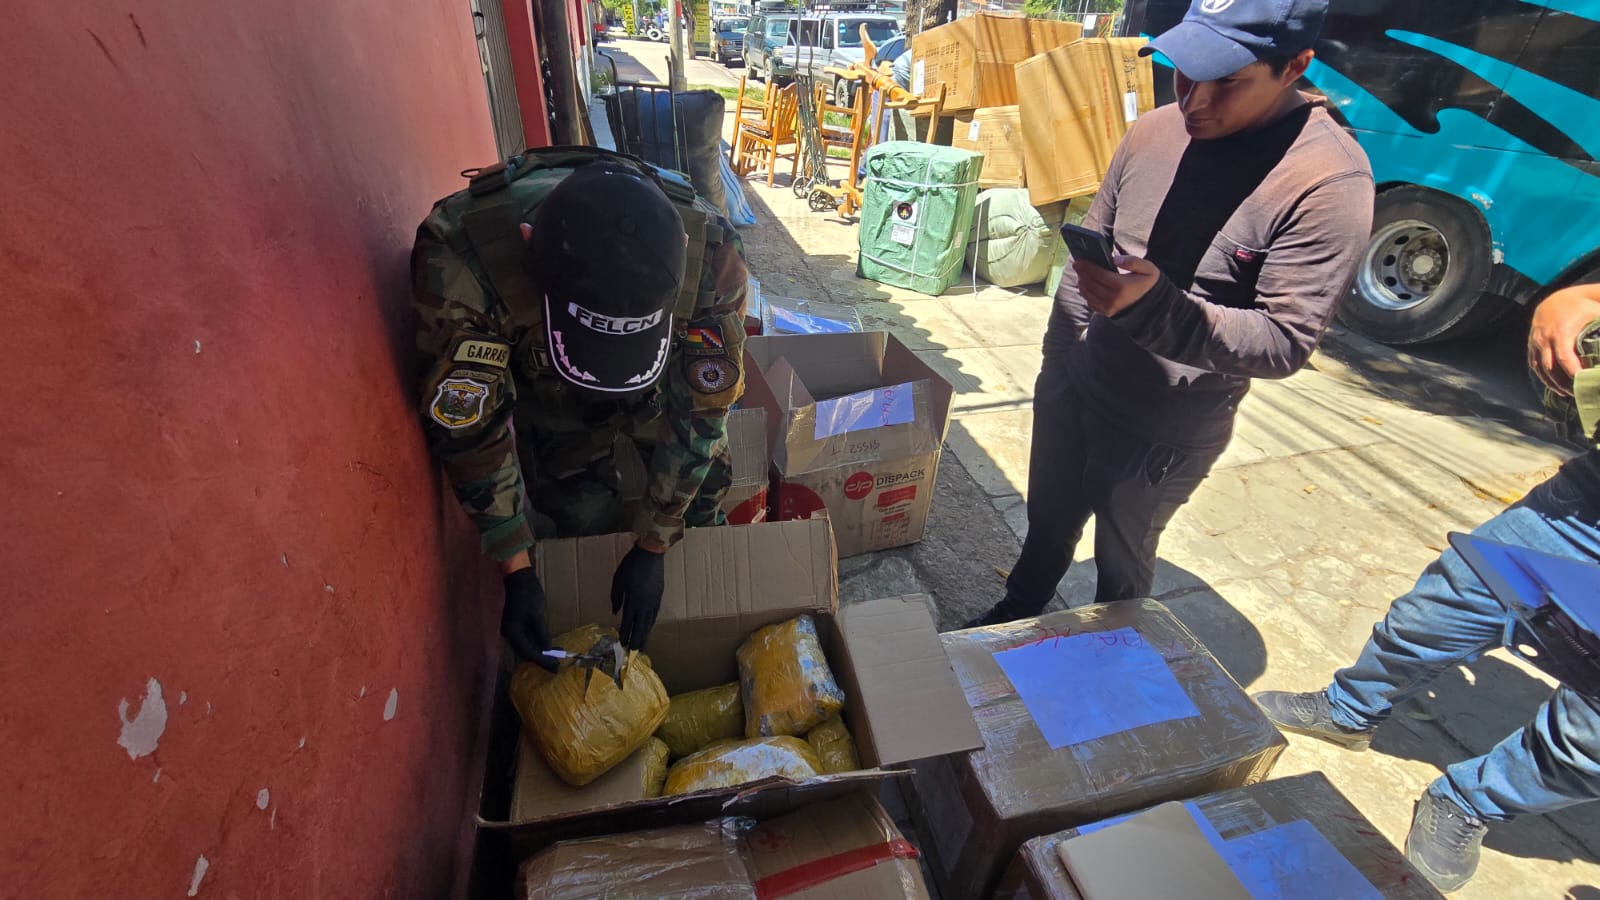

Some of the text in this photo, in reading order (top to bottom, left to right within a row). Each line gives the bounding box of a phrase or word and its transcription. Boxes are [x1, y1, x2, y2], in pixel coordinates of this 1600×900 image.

[575, 307, 657, 333] FELCN
[467, 344, 508, 363] GARRAS
[876, 468, 925, 486] DISPACK
